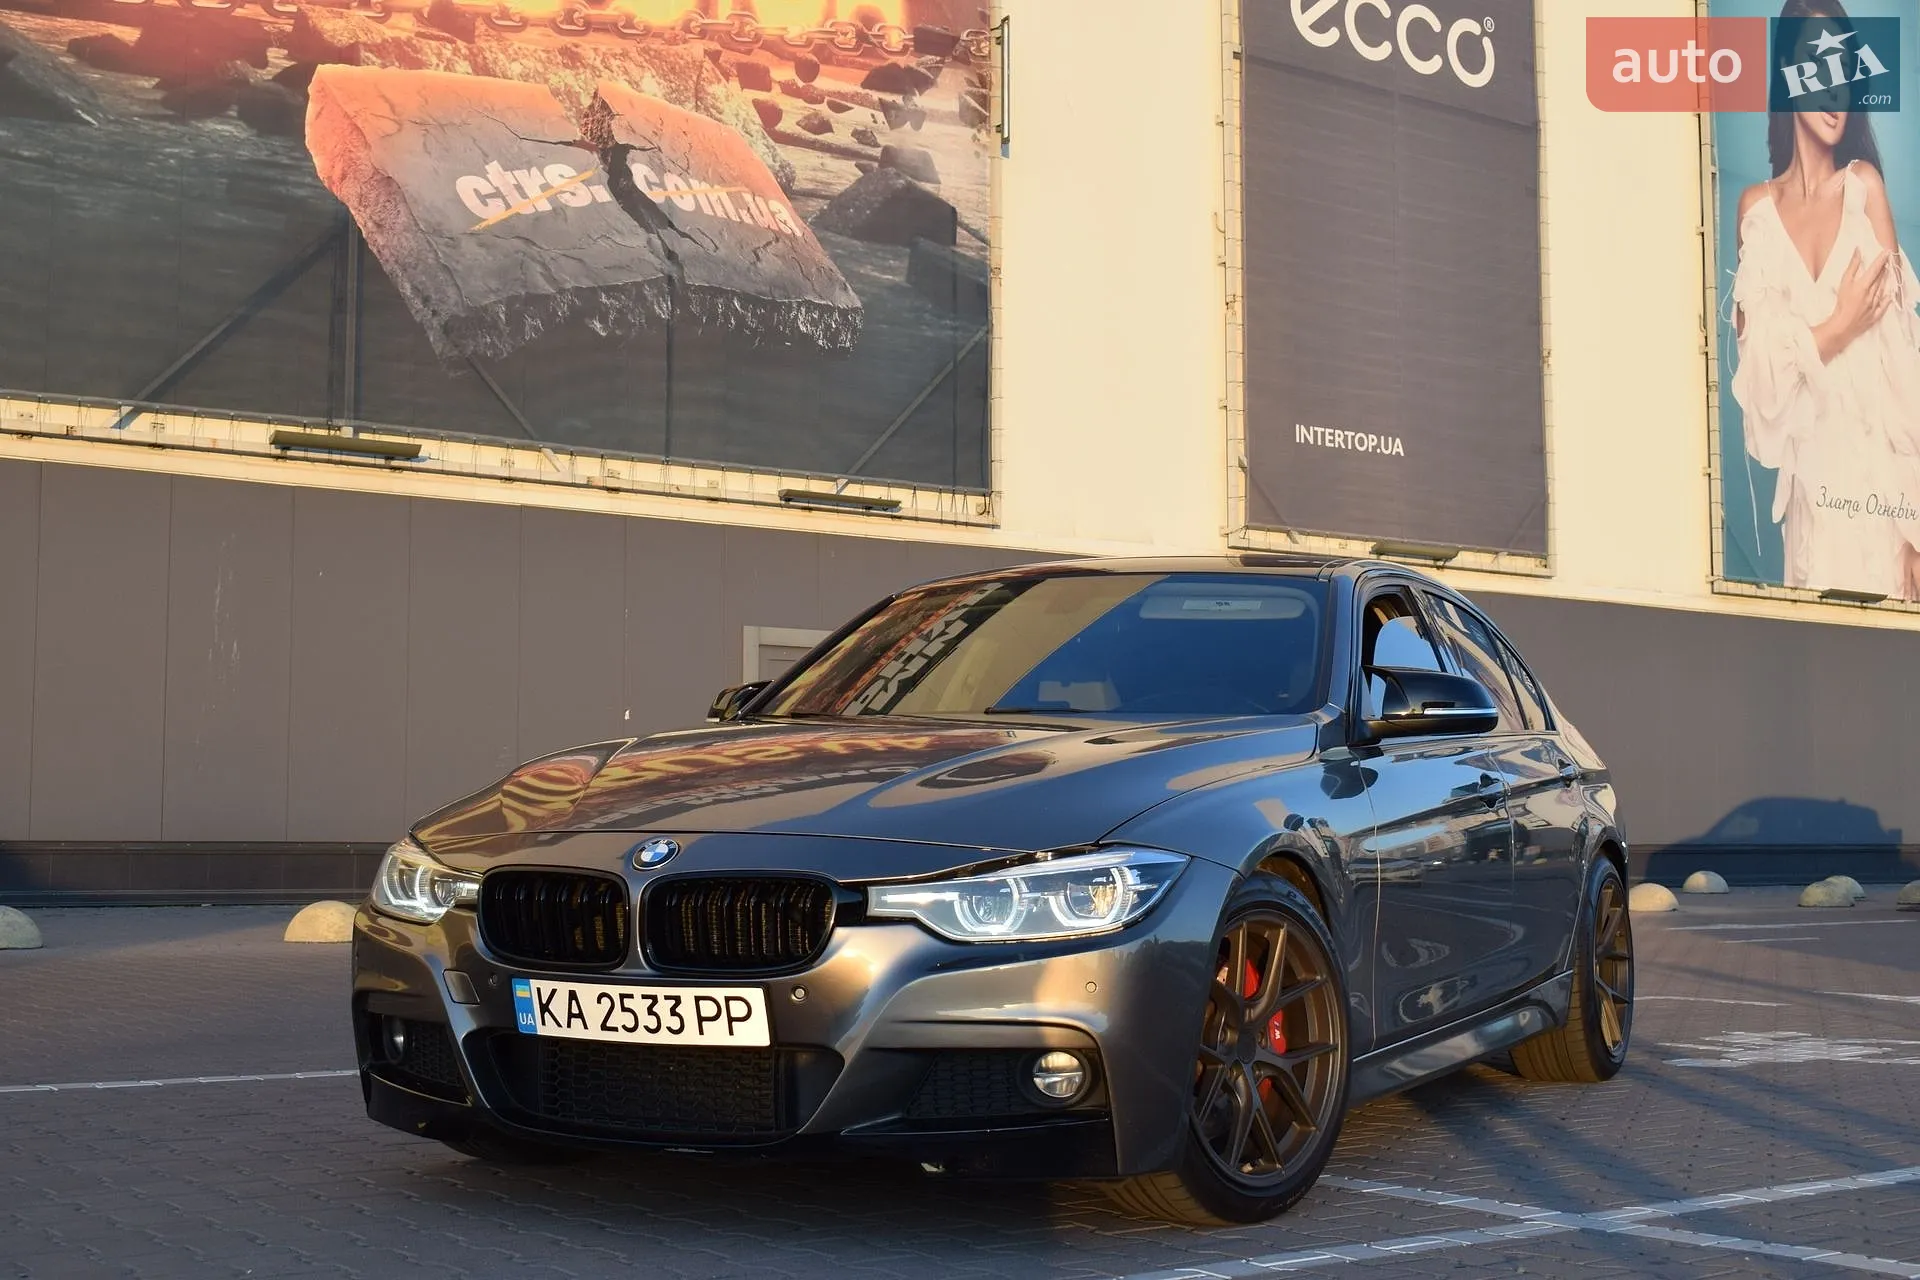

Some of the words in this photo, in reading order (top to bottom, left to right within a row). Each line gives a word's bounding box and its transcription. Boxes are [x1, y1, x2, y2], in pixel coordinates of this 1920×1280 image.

[1290, 0, 1495, 88] ecco
[1295, 424, 1405, 457] INTERTOP.UA
[1816, 486, 1860, 519] Злата
[519, 1012, 535, 1026] UA
[536, 987, 589, 1030] KA
[596, 992, 686, 1035] 2533
[694, 995, 753, 1036] PP
